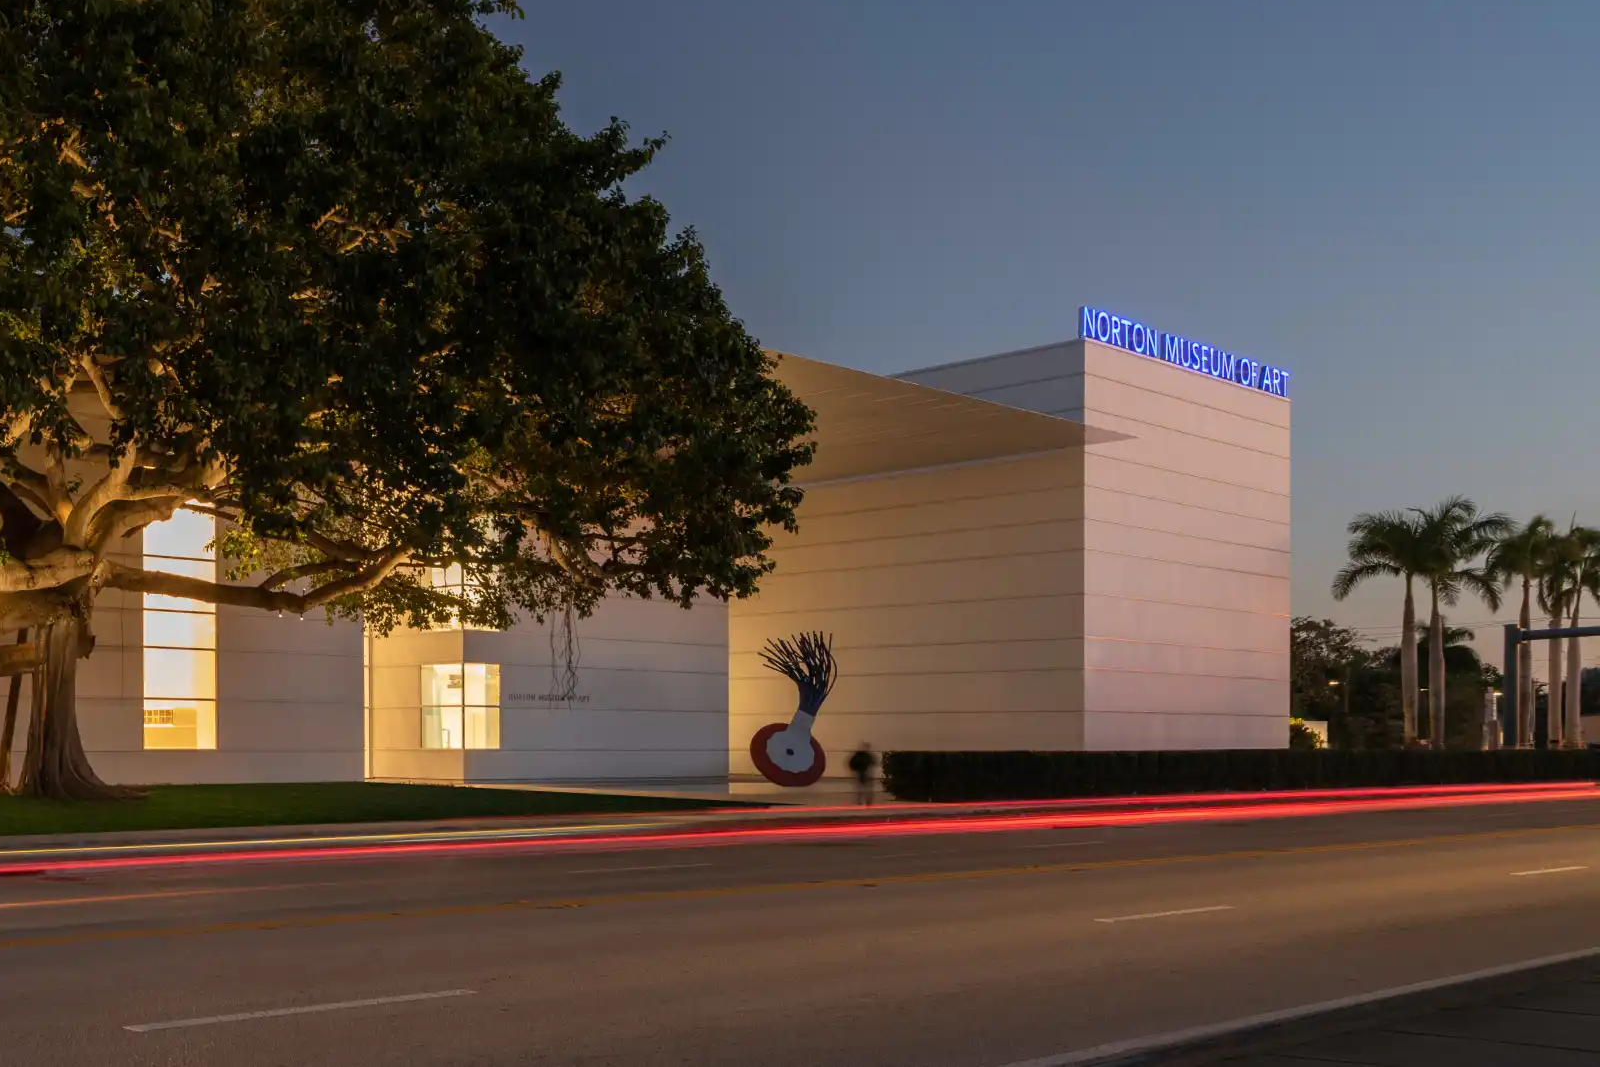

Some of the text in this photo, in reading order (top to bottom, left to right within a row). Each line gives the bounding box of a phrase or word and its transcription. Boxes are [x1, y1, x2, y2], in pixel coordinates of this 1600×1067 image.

[1082, 306, 1290, 397] NORTON MUSEUM OF ART
